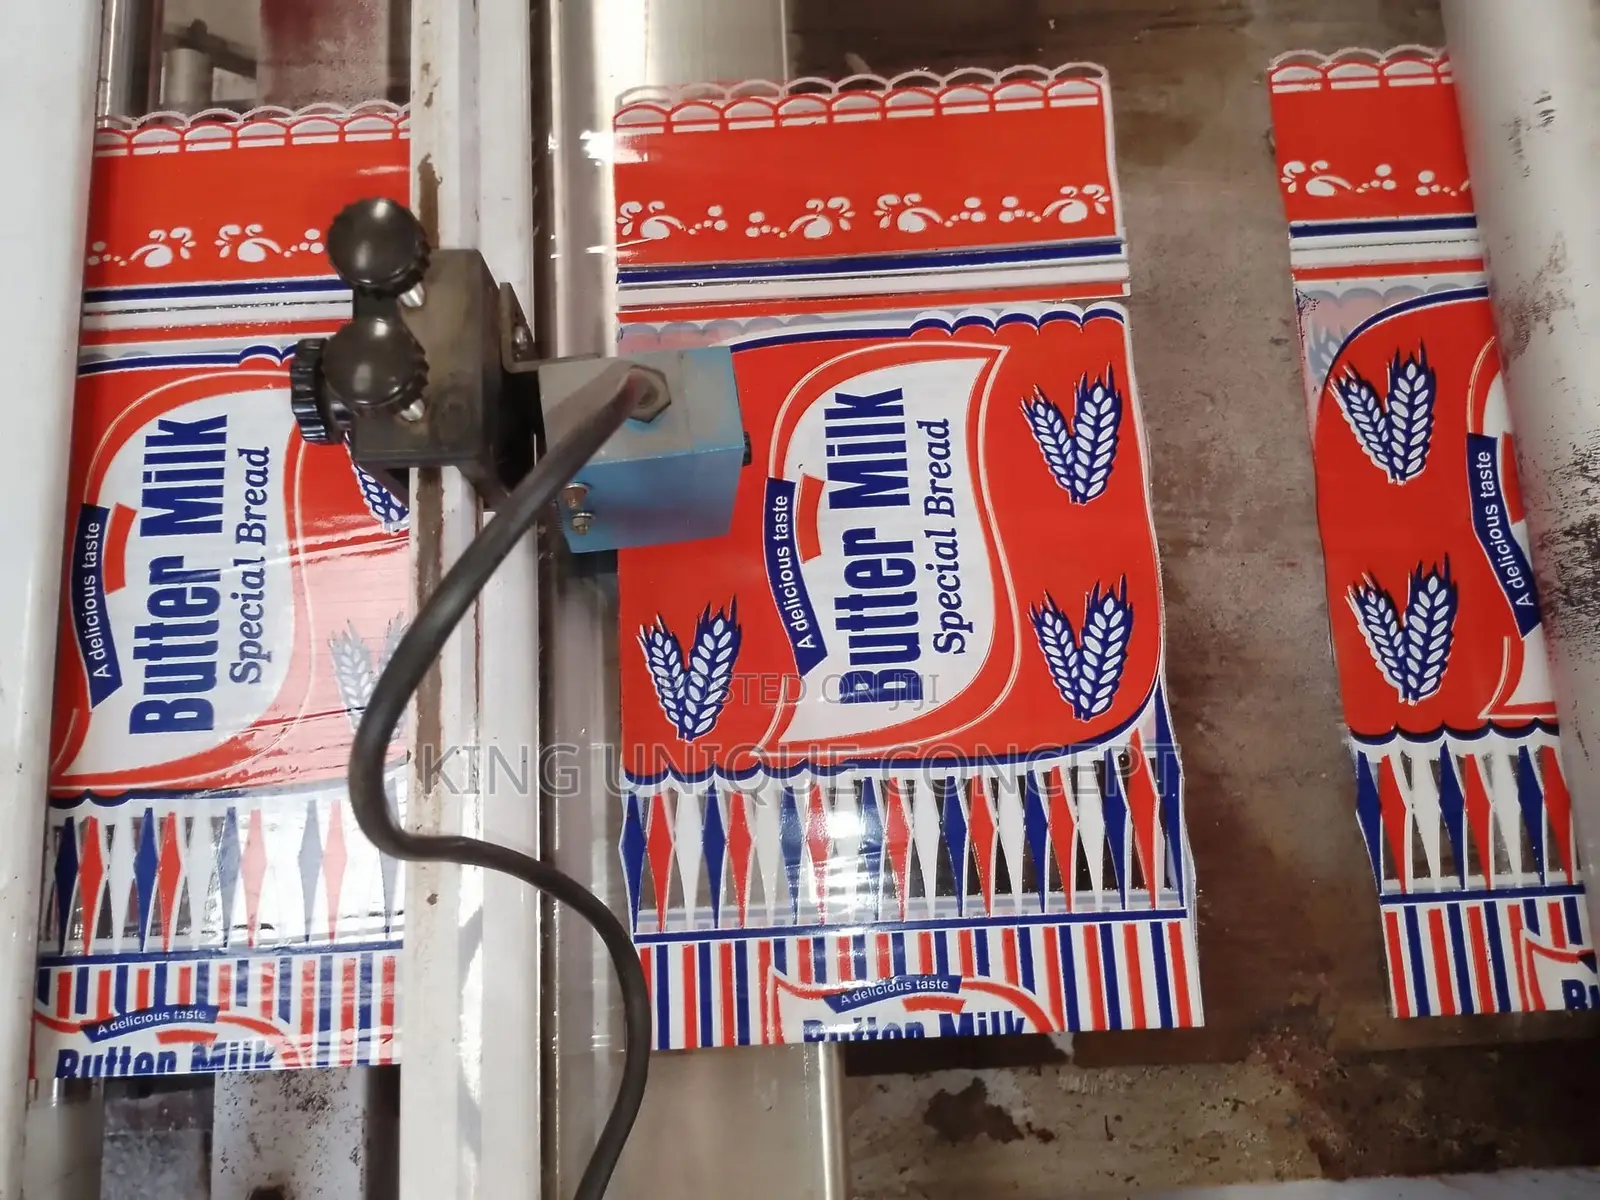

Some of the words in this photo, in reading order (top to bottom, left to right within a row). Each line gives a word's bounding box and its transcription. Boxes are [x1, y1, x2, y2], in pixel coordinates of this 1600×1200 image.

[139, 414, 228, 538] Milk
[824, 387, 910, 509] Milk
[916, 418, 956, 519] Bread
[1477, 451, 1495, 499] taste
[236, 446, 271, 546] Bread
[772, 494, 789, 541] taste
[82, 520, 100, 571] taste
[778, 545, 809, 632] delicious
[1483, 503, 1524, 589] delicious
[81, 573, 106, 660] delicious
[229, 556, 273, 684] Special
[834, 527, 924, 704] Butter
[924, 528, 974, 655] Special
[1515, 593, 1535, 607] A
[93, 662, 111, 679] A
[129, 555, 221, 735] Butter
[797, 633, 817, 649] A
[97, 1024, 108, 1037] A
[110, 1011, 170, 1032] delicious
[174, 1009, 207, 1021] taste
[840, 993, 851, 1006] A
[852, 980, 912, 1001] delicious
[915, 978, 949, 990] taste
